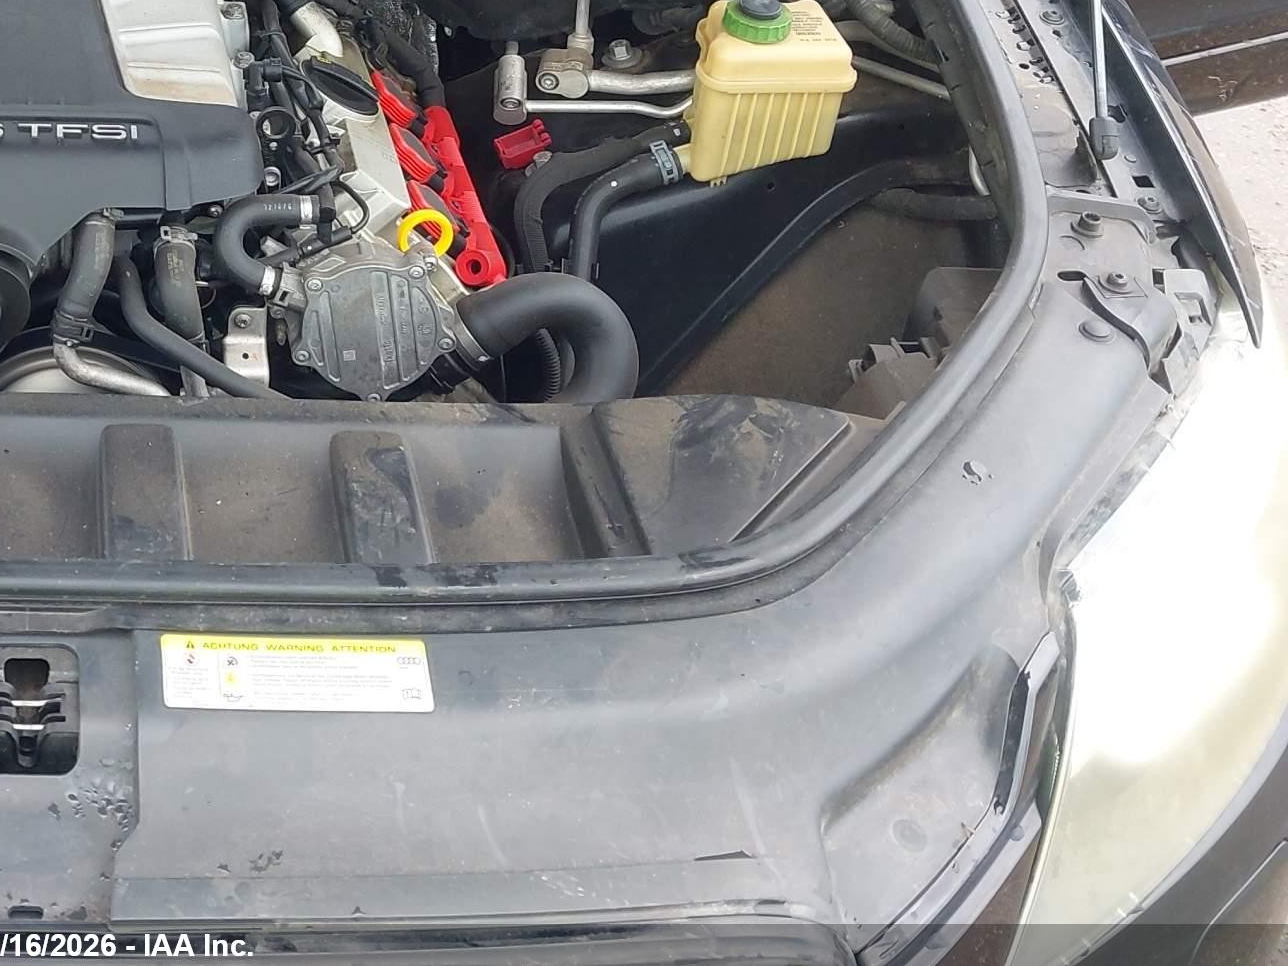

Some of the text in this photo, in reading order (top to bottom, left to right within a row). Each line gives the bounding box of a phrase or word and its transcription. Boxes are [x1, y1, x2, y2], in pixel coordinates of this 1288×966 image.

[17, 122, 139, 141] TFSI
[202, 642, 396, 653] ACHTUNG WARNING ATTENTION
